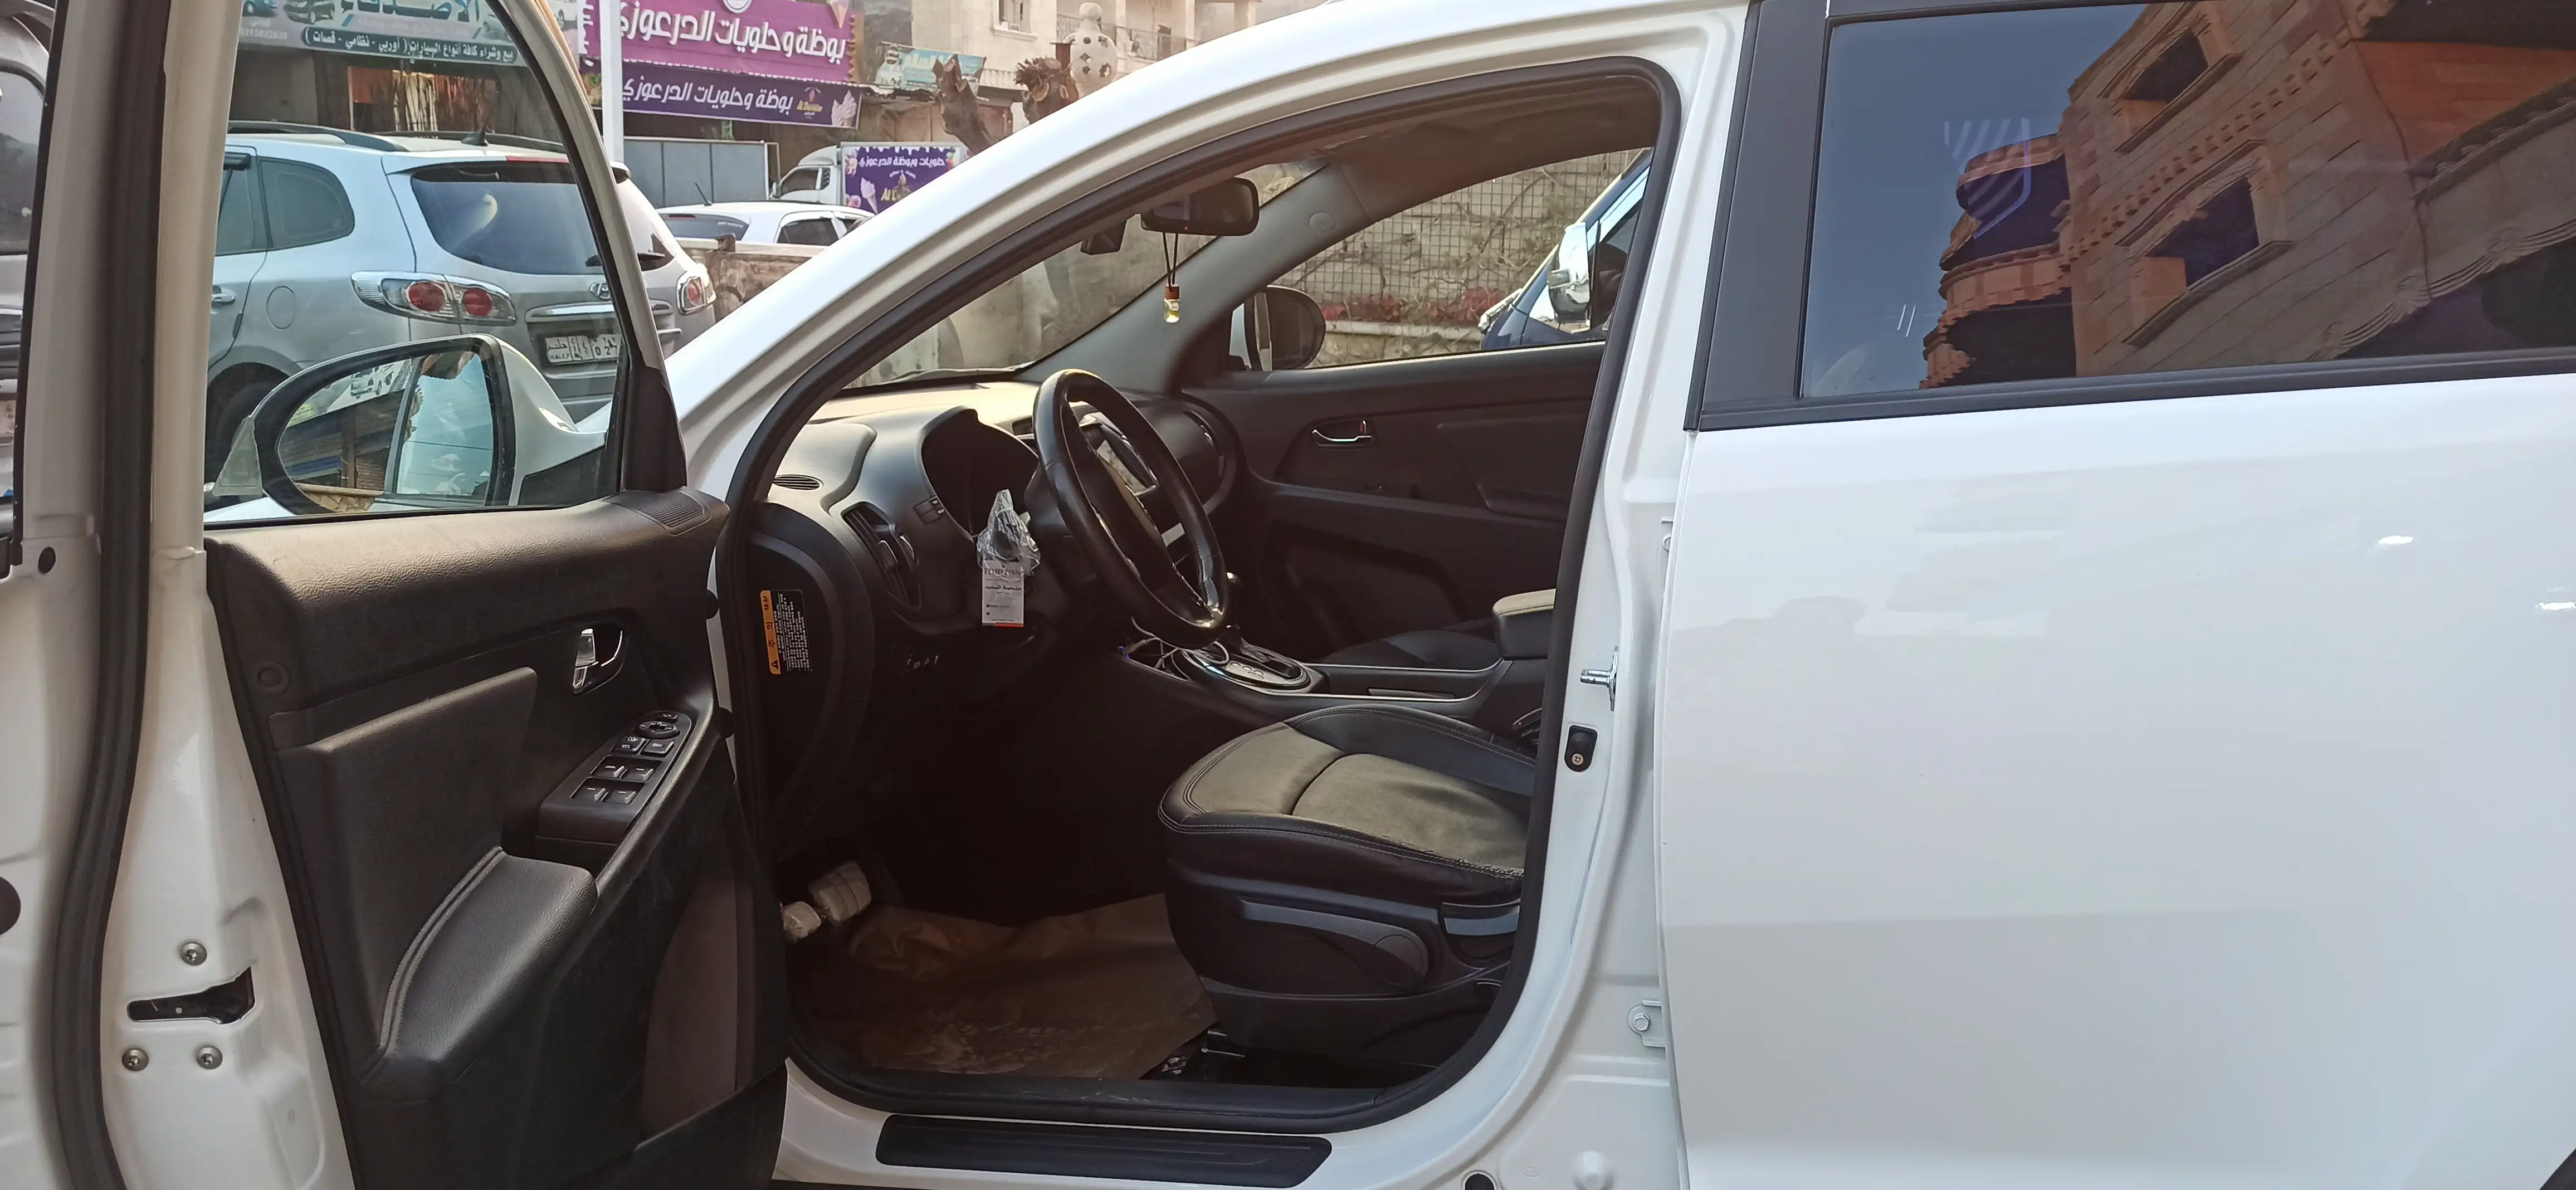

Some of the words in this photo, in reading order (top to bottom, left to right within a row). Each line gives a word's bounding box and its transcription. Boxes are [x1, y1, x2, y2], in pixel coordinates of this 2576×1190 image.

[443, 42, 461, 58] أنواع
[462, 44, 477, 56] كافة
[796, 26, 846, 65] بوظة
[480, 46, 501, 61] وشراء
[502, 50, 514, 62] بيع
[622, 75, 694, 103] الدرعوزي
[694, 85, 754, 110] وحلويات
[755, 88, 793, 115] بوظة
[858, 156, 892, 168] الدرعوزي
[892, 155, 918, 168] وبوظة
[919, 157, 945, 168] حلويات
